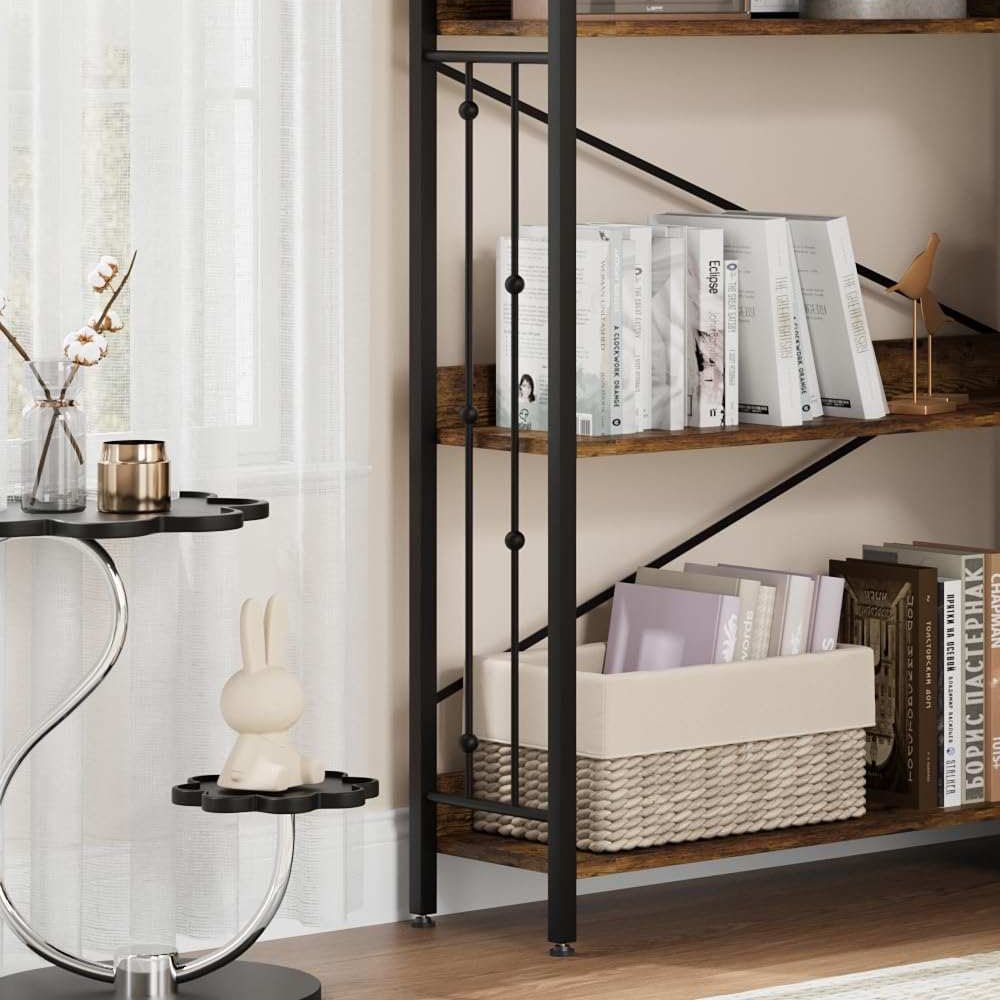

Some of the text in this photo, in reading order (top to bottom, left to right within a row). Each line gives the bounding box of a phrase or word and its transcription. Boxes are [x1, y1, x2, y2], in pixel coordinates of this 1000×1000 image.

[706, 260, 721, 294] Eclipse
[727, 282, 737, 292] THE
[727, 294, 737, 311] GREAT
[798, 368, 807, 394] ORANGE
[946, 594, 956, 672] ПРЯТКИ НА ОСЕВОЙ
[964, 567, 985, 789] БОРИС ПАСТЕРНАК
